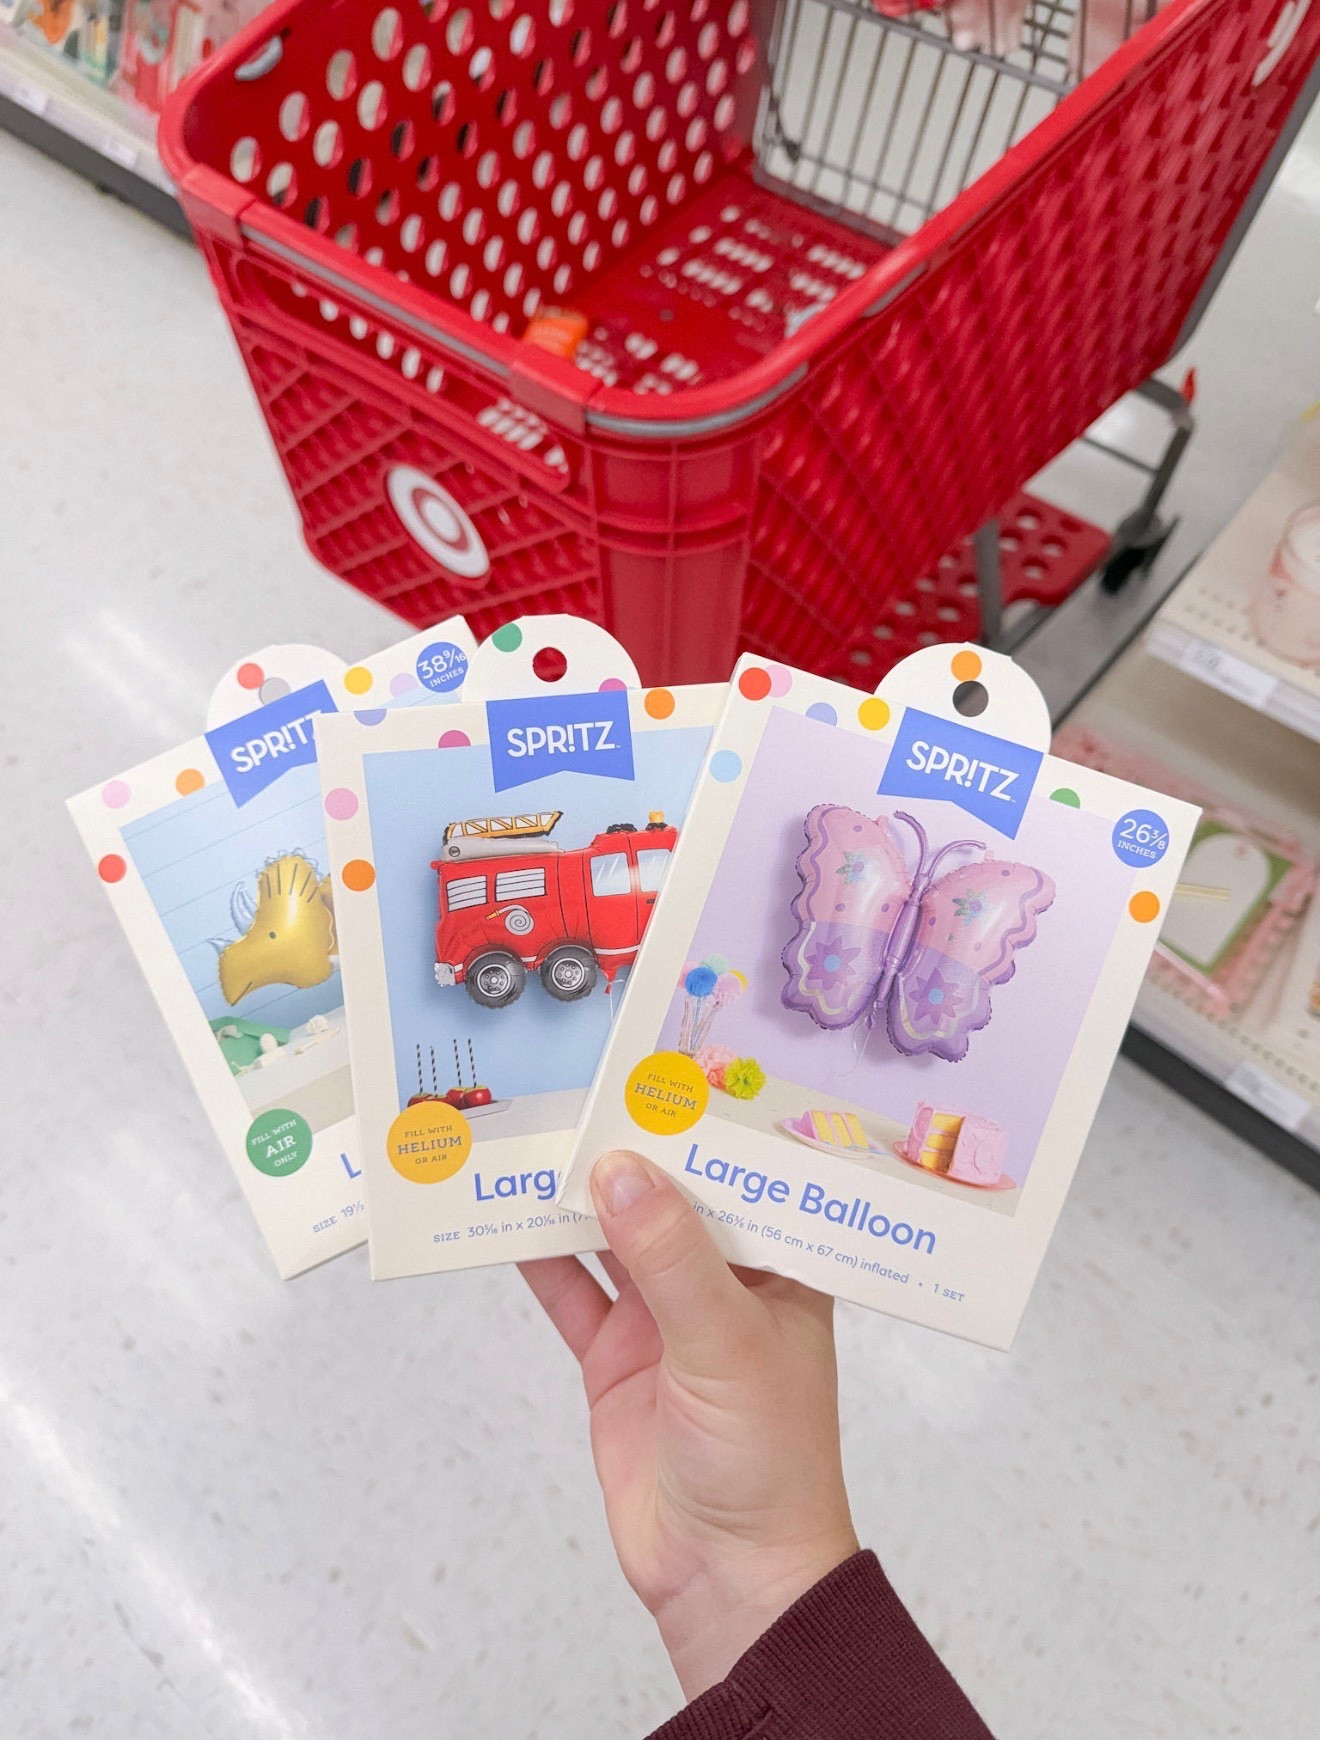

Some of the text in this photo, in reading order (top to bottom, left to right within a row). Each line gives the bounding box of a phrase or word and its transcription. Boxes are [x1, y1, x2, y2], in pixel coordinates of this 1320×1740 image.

[430, 667, 464, 688] INCHES
[1117, 839, 1157, 859] INCHES
[648, 1073, 694, 1093] FILL WITH
[634, 1082, 697, 1110] HELIUM
[645, 1102, 677, 1118] OR AIR
[251, 1119, 298, 1147] FILL WITH
[404, 1125, 453, 1138] FILL WITH
[265, 1135, 297, 1158] AIR
[397, 1136, 462, 1155] HELIUM
[273, 1151, 298, 1168] ONLY
[415, 1154, 448, 1165] OR AIR
[474, 1169, 561, 1201] Larg
[684, 1143, 936, 1255] Large Balloon
[312, 1215, 338, 1233] SIZE
[433, 1231, 461, 1243] SIZE
[501, 1221, 513, 1233] in
[516, 1222, 524, 1230] x
[558, 1212, 570, 1224] in
[747, 1219, 759, 1233] in
[761, 1225, 782, 1241] (56
[784, 1235, 804, 1249] cm
[806, 1243, 814, 1253] x
[817, 1244, 834, 1257] 67
[834, 1251, 859, 1268] cm)
[860, 1258, 910, 1284] inflated
[942, 1288, 966, 1302] SET
